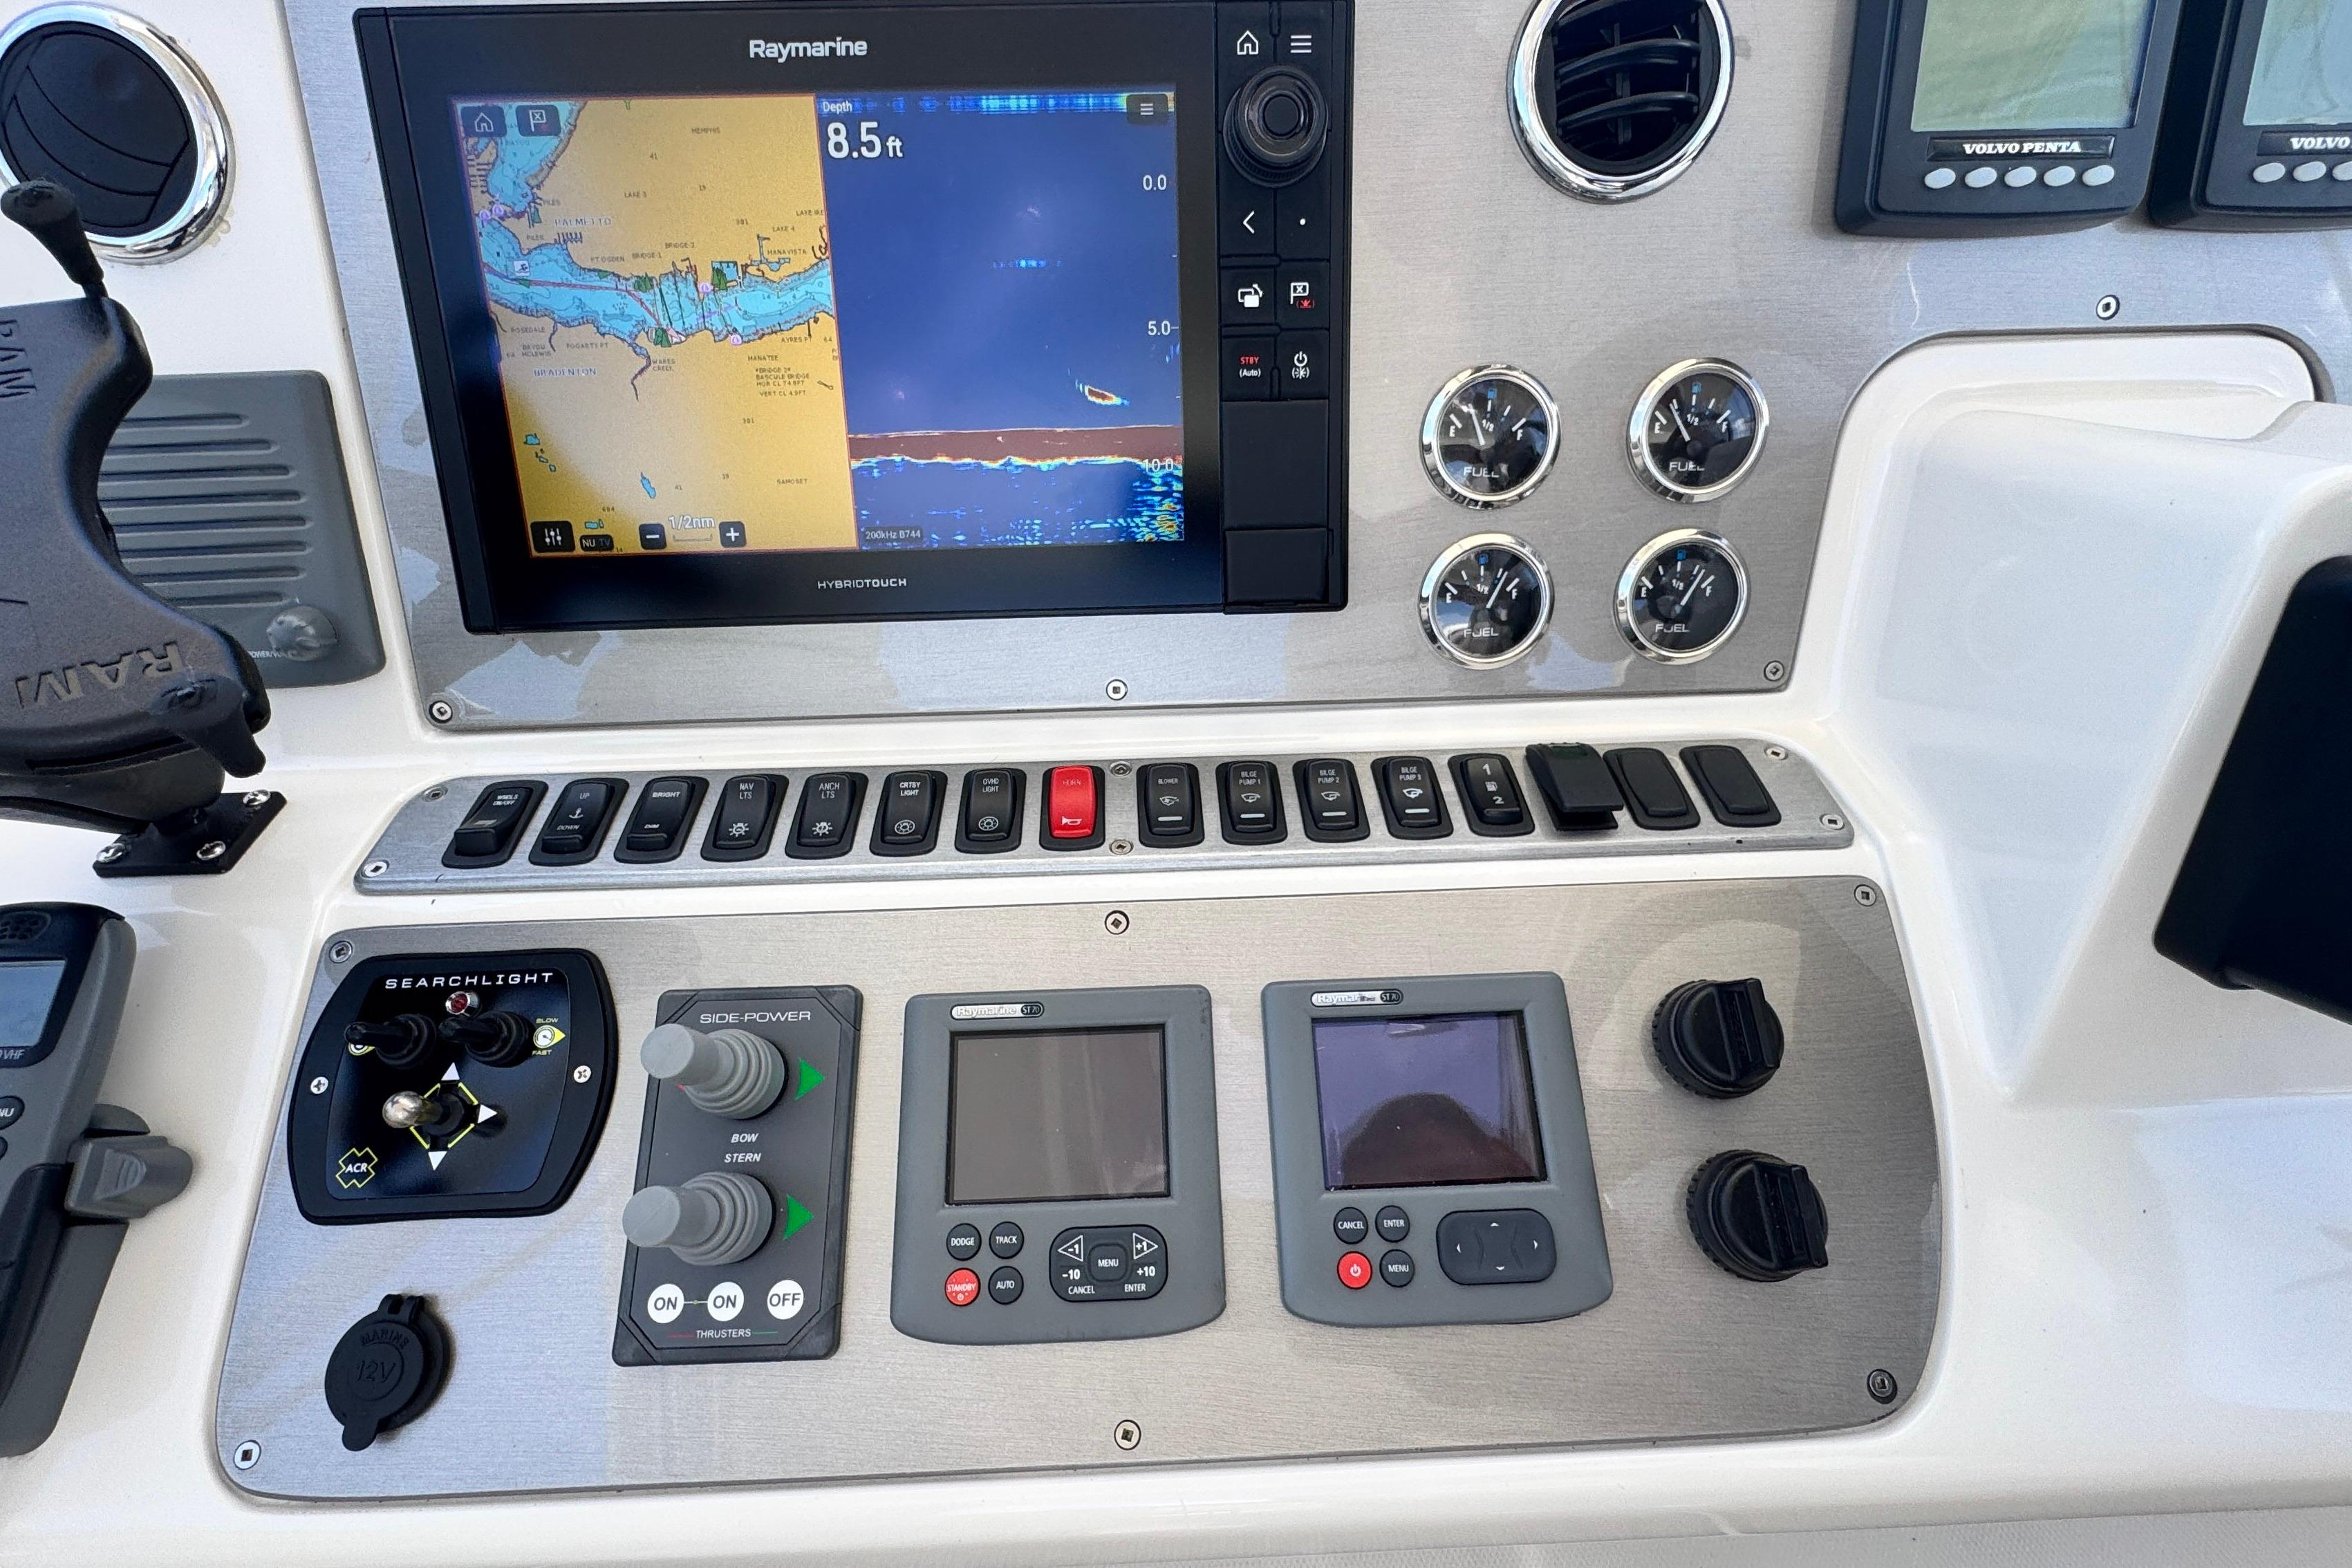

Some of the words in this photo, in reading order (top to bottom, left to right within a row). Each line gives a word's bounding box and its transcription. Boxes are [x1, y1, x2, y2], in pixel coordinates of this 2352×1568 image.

[749, 37, 867, 63] Raymarine
[823, 100, 852, 114] Depth
[828, 122, 881, 158] 8.5
[886, 136, 903, 158] ft
[2290, 137, 2350, 149] VOLVO
[1962, 142, 2020, 154] VOLVO
[2022, 141, 2081, 153] PENTA
[1143, 174, 1167, 190] 0.0
[1148, 321, 1170, 335] 5.0
[1240, 356, 1259, 364] STBY
[534, 368, 596, 376] BRADENTON
[1240, 368, 1261, 377] (Auto)
[1449, 426, 1456, 437] E
[1654, 422, 1661, 433] E
[1722, 422, 1728, 433] F
[1517, 429, 1523, 440] F
[1464, 467, 1499, 477] FUEL
[1669, 461, 1705, 472] FUEL
[669, 516, 715, 530] 1/2nm
[866, 530, 897, 540] 200kHz
[582, 539, 595, 548] NU
[818, 578, 907, 589] HYBRIDTOUCH
[1512, 588, 1518, 599] F
[1641, 587, 1647, 598] E
[1706, 586, 1712, 597] F
[1446, 592, 1452, 604] E
[1464, 628, 1499, 637] FUEL
[1655, 624, 1690, 633] FUEL
[15, 641, 185, 709] RAM
[1482, 763, 1491, 775] 1
[739, 782, 755, 790] NAV
[819, 782, 840, 792] ANCH
[739, 792, 753, 800] LTS
[821, 791, 835, 799] LTS
[1493, 796, 1504, 804] 2
[385, 973, 553, 989] SEARCHLIGHT
[1316, 993, 1376, 1005] Raymarine
[1381, 993, 1390, 1001] ST
[700, 1011, 811, 1024] SIDE-POWER
[957, 1006, 1016, 1018] Raymarine
[1023, 1006, 1030, 1014] ST
[3, 1049, 26, 1060] VHF
[731, 1132, 759, 1144] BOW
[725, 1153, 761, 1164] STERN
[346, 1162, 368, 1173] ACR
[1338, 1220, 1365, 1230] CANCEL
[1383, 1219, 1405, 1228] ENTER
[951, 1237, 975, 1247] DODGE
[996, 1235, 1018, 1244] TRACK
[1067, 1244, 1079, 1255] -1
[1135, 1241, 1148, 1251] +1
[1098, 1258, 1119, 1268] MENU
[1388, 1264, 1410, 1273] MENU
[1062, 1269, 1081, 1280] -10
[1137, 1266, 1156, 1277] +10
[947, 1283, 977, 1292] STANDBY
[996, 1280, 1016, 1289] AUTO
[1124, 1284, 1146, 1293] ENTER
[1068, 1286, 1095, 1295] CANCEL
[653, 1296, 678, 1311] ON
[713, 1295, 737, 1309] ON
[769, 1292, 801, 1307] OFF
[696, 1329, 752, 1339] THRUSTERS
[354, 1360, 397, 1383] 12V
